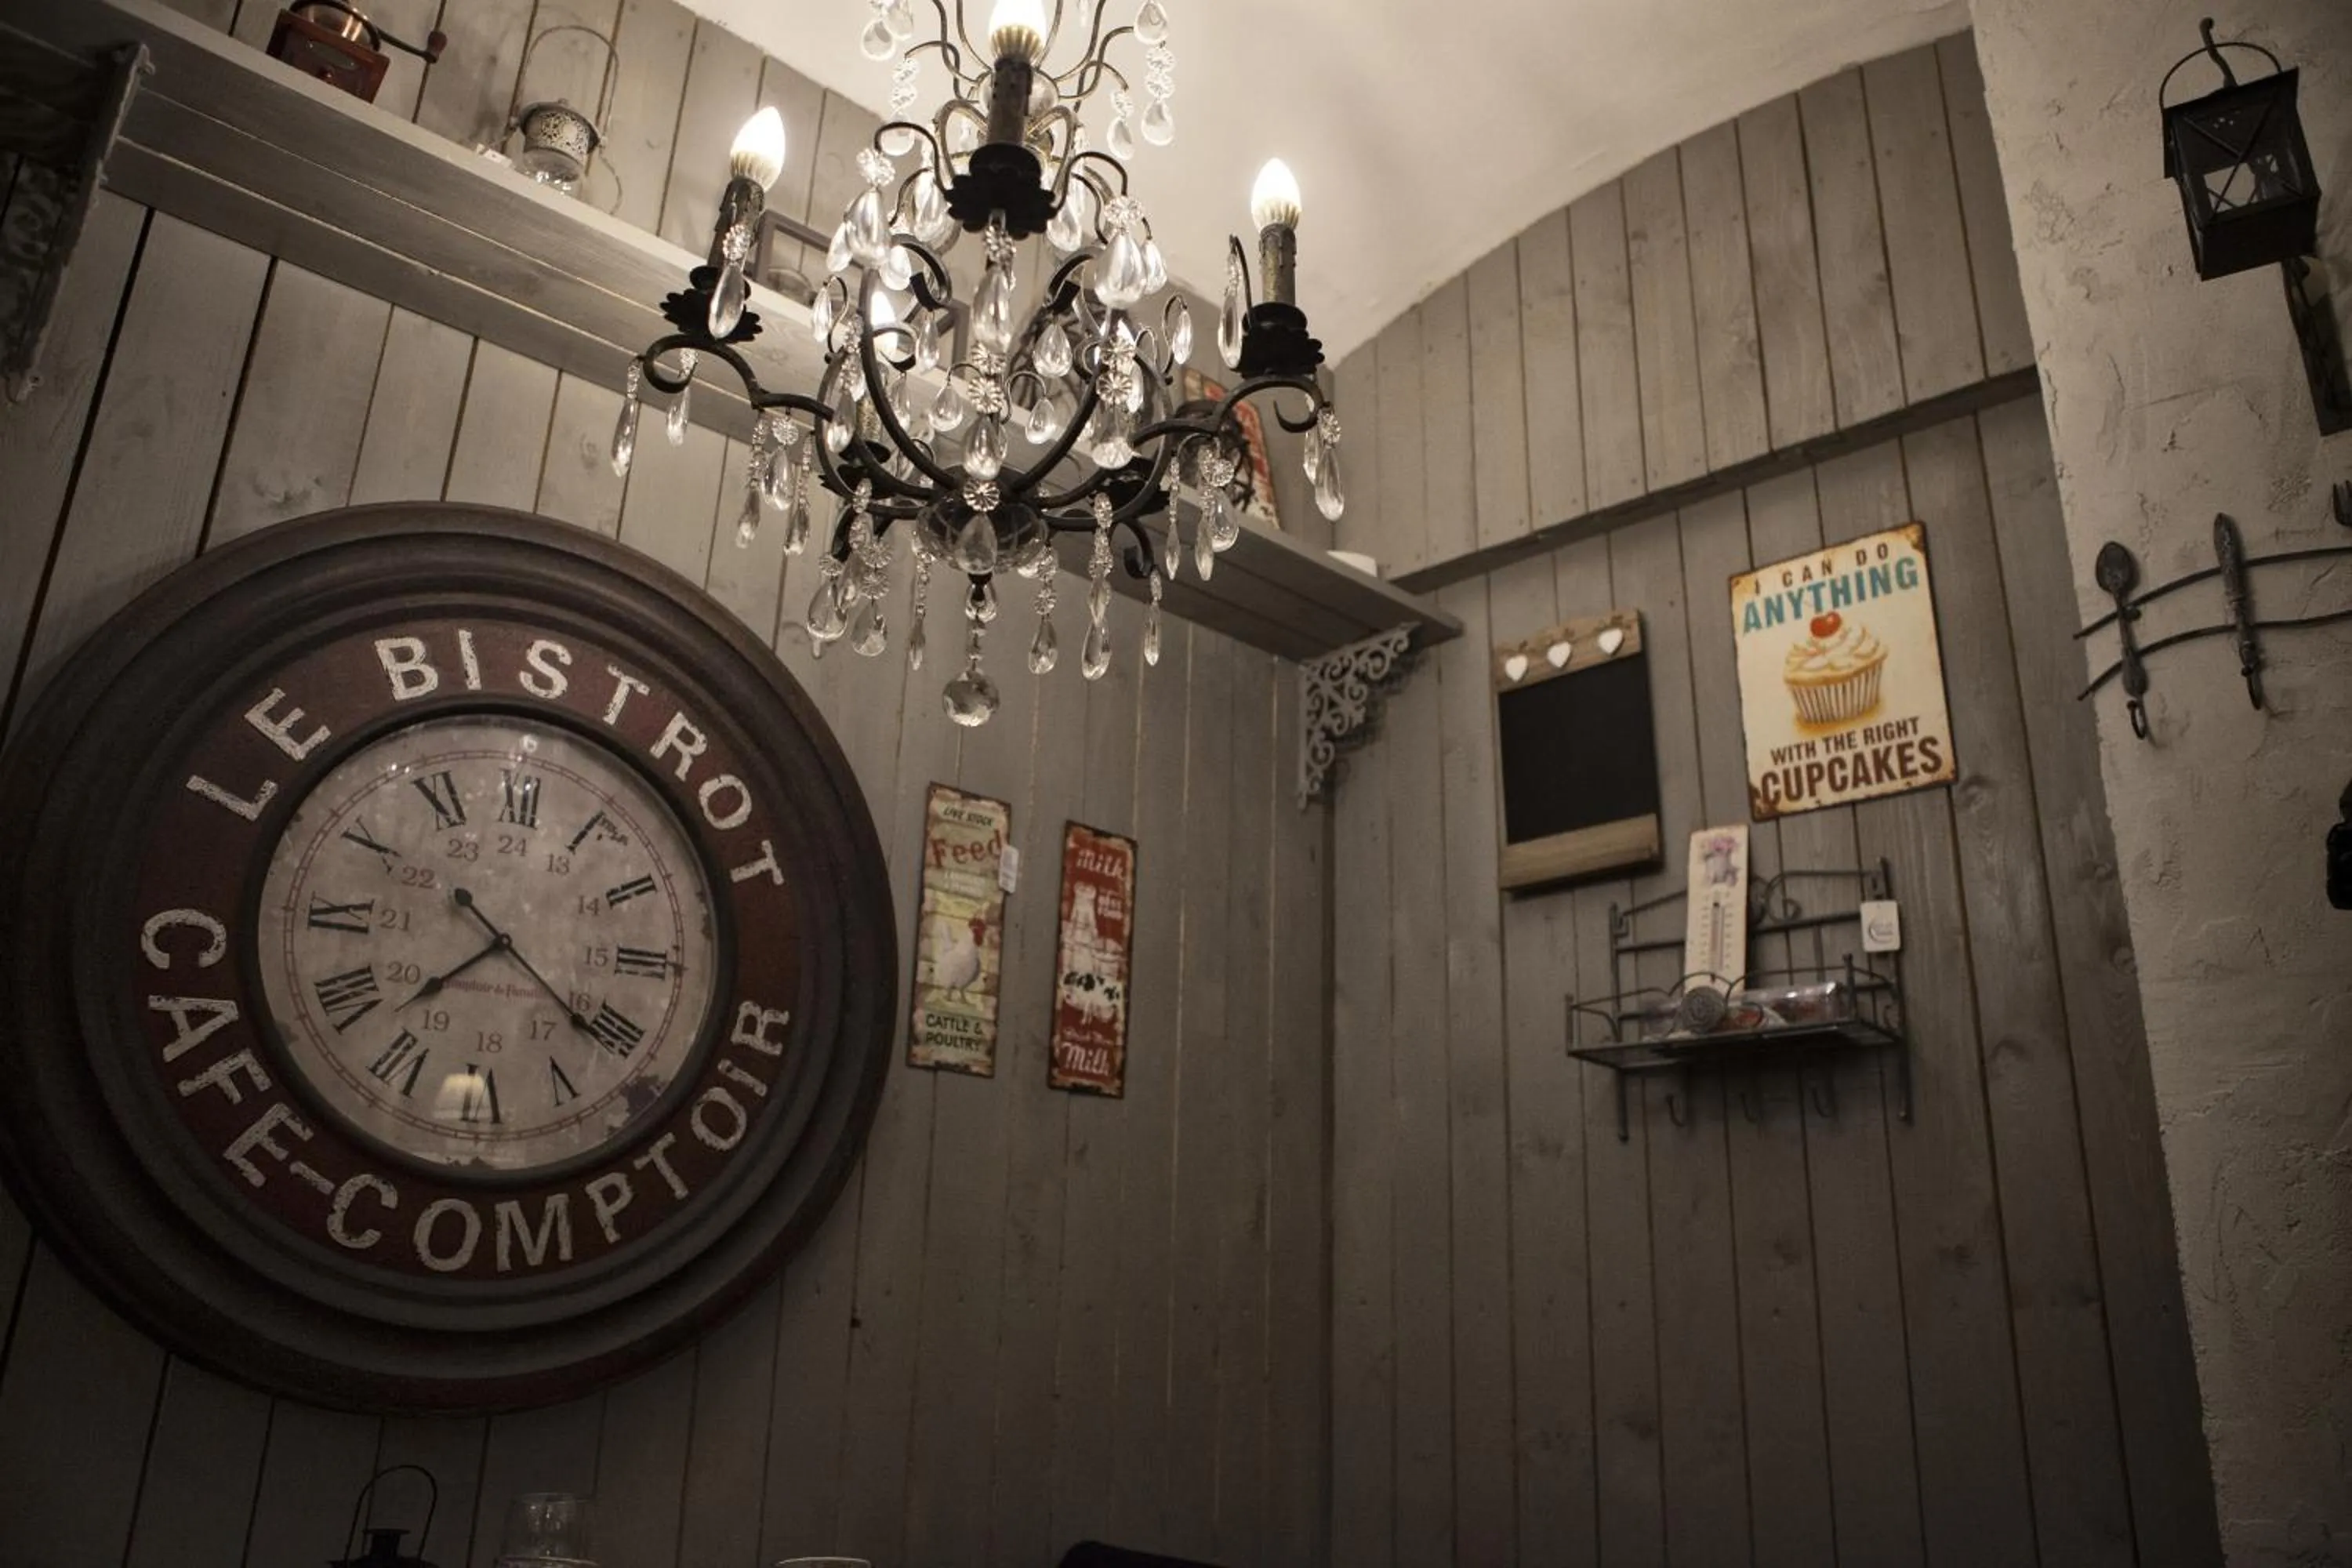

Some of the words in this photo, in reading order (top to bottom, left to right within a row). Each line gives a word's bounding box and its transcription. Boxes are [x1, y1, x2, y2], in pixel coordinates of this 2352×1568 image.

[1754, 577, 1762, 595] I
[1781, 557, 1833, 587] CAN
[1855, 543, 1889, 566] DO
[1742, 556, 1919, 633] ANYTHING
[1770, 740, 1817, 766] WITH
[1821, 730, 1857, 752] THE
[1862, 716, 1921, 746] RIGHT
[186, 687, 331, 822] LE
[375, 630, 784, 885] BISTROT
[1759, 735, 1943, 808] CUPCAKES
[447, 839, 479, 862] 23
[498, 834, 526, 856] 24
[930, 828, 1002, 869] Feed
[547, 853, 570, 875] 13
[401, 866, 435, 888] 22
[578, 895, 599, 916] 14
[379, 908, 412, 929] 21
[583, 946, 608, 967] 15
[386, 963, 421, 985] 20
[569, 991, 590, 1012] 16
[423, 1010, 450, 1032] 19
[530, 1020, 557, 1040] 17
[926, 1014, 969, 1033] CATTLE
[476, 1031, 503, 1053] 18
[925, 1032, 982, 1051] POULTRY
